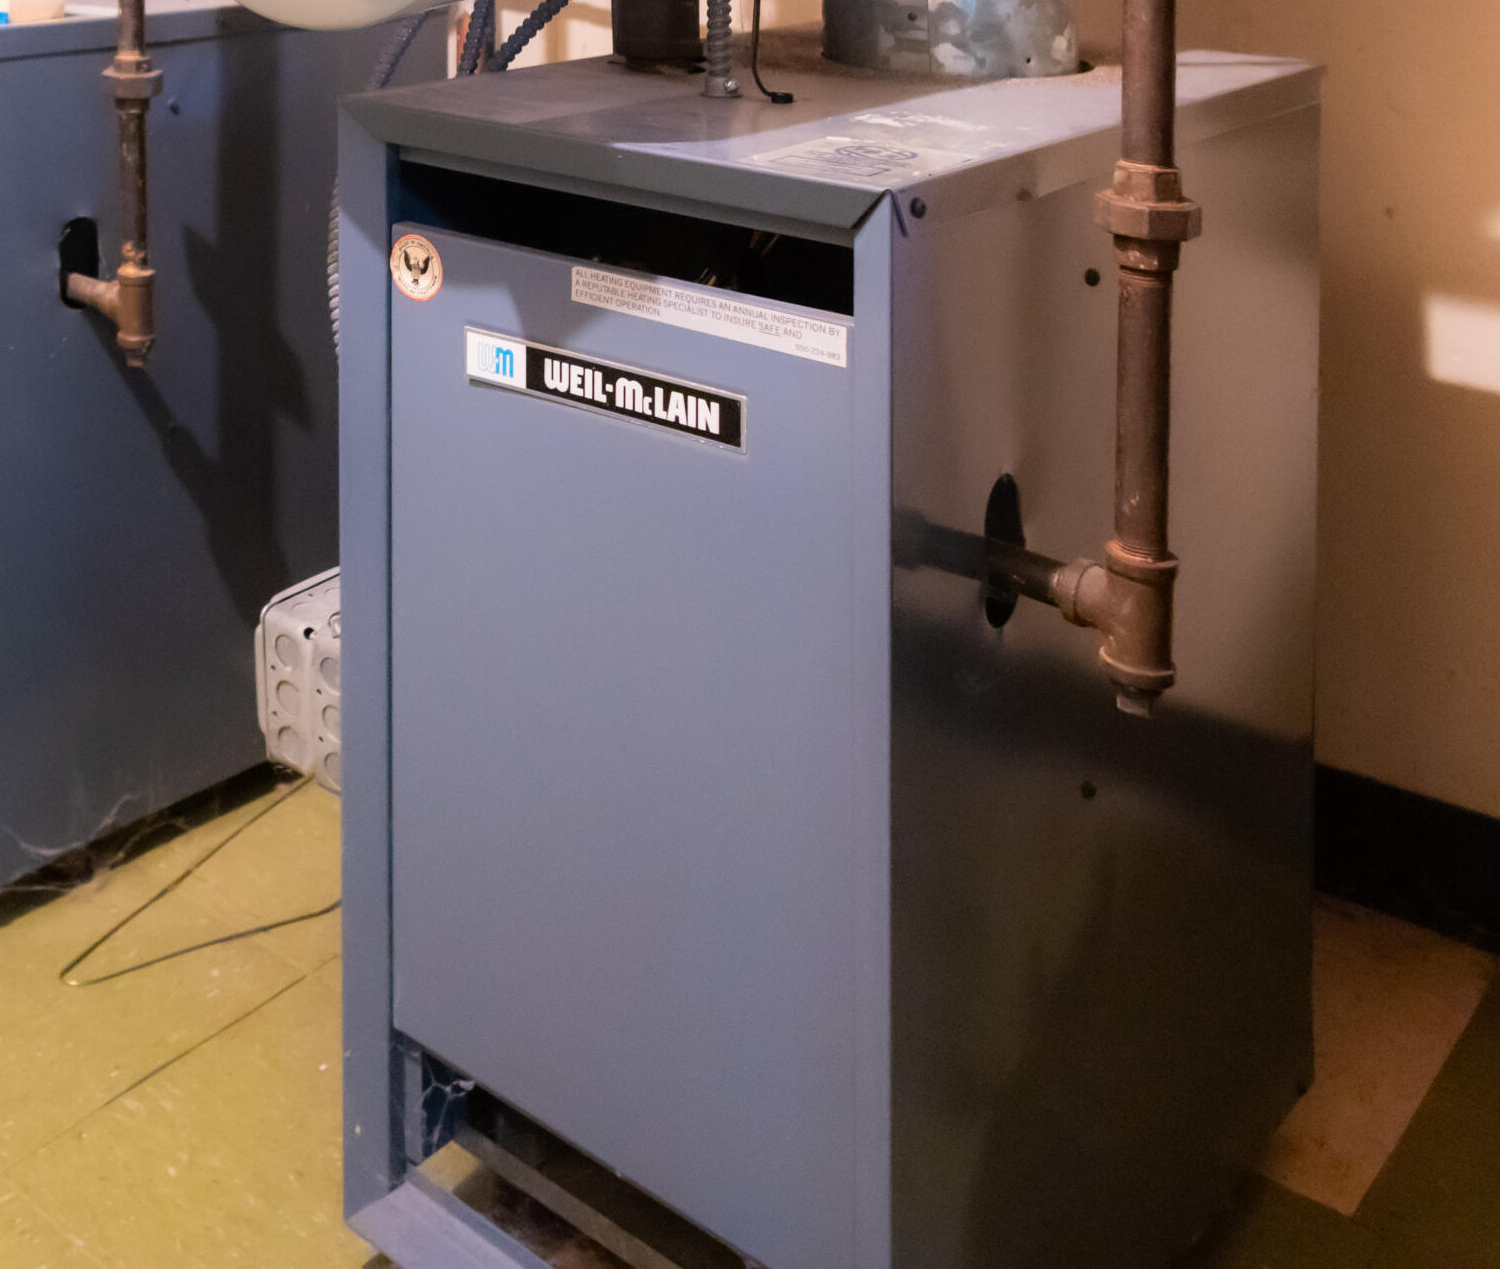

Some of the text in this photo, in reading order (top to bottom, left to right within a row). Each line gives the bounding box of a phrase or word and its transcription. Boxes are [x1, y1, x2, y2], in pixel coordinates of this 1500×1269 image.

[575, 269, 841, 337] ALL HEATING EQUIPMENT REQUIRES AN ANNUAL INSPECTION BY
[575, 289, 661, 317] EFFICIENT OPERATION
[581, 281, 626, 297] REPUTABLE
[627, 291, 662, 307] HEATING
[663, 300, 710, 317] SPECIALIST
[711, 310, 722, 321] TO
[723, 314, 757, 330] INSURE
[758, 323, 781, 335] SAFE
[782, 327, 803, 340] AND
